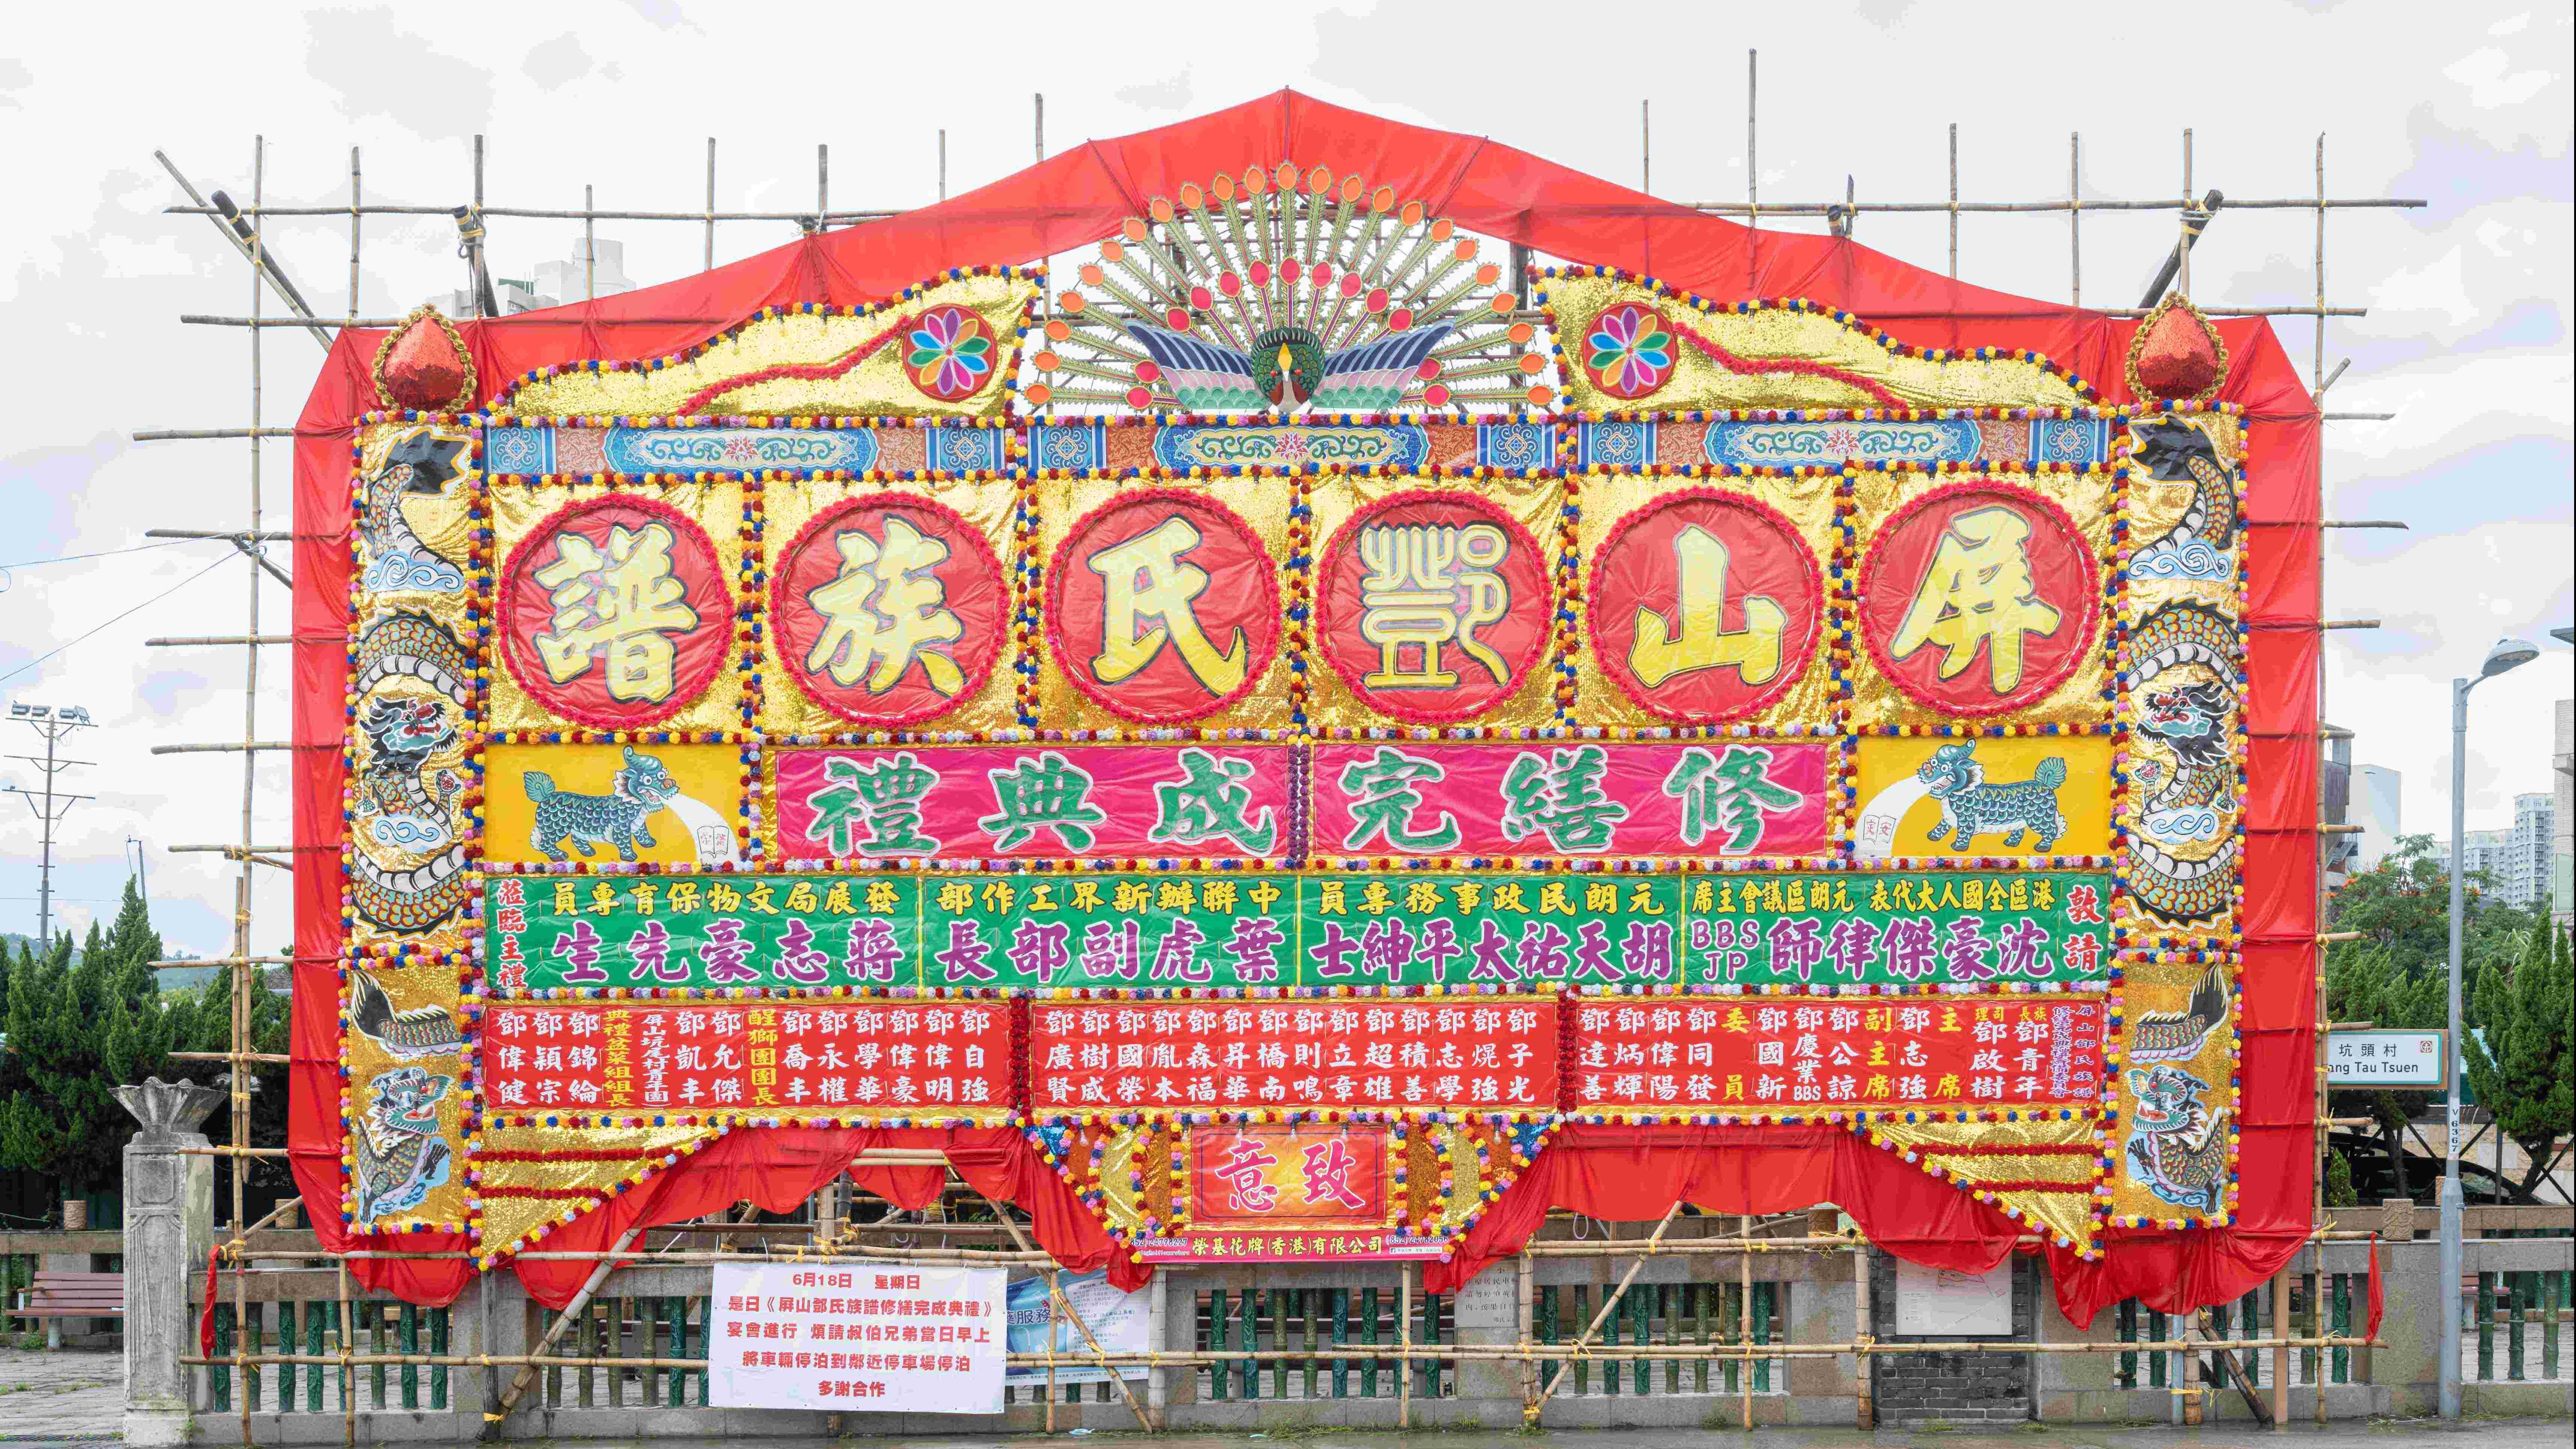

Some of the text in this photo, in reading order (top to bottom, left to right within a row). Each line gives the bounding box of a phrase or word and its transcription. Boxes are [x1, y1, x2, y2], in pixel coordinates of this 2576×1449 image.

[531, 504, 2062, 702] 屏山鄧氏族譜
[806, 744, 1805, 858] 修繕完成典禮
[496, 878, 528, 990] 蒞臨主禮
[552, 879, 902, 917] 發展局文物保育專員
[936, 880, 1283, 916] 中聯辦新界工作部
[1317, 880, 1666, 917] 元朗民政事務專員
[1690, 919, 1760, 950] BBS
[1692, 878, 2055, 915] 港區全國人大代表 元朗區議會主席
[2062, 884, 2105, 975] 敦請
[552, 918, 906, 983] 蔣志豪先生
[934, 918, 1286, 983] 葉虎副部長
[1308, 918, 1674, 983] 胡天祐太平紳士
[1703, 950, 1748, 981] JP
[1766, 916, 2055, 982] 沈豪傑律師
[531, 1012, 563, 1103] 鄧穎宗
[567, 1012, 602, 1104] 鄧錦綸
[748, 1009, 780, 1106] 醒獅團團長
[816, 1010, 850, 1103] 鄧永權
[852, 1010, 883, 1103] 鄧學華
[889, 1009, 920, 1103] 鄧偉豪
[923, 1009, 954, 1102] 鄧偉明
[958, 1010, 990, 1102] 鄧自強
[1044, 1010, 1076, 1103] 鄧廣賢
[1079, 1010, 1111, 1103] 鄧樹威
[1115, 1010, 1146, 1103] 鄧國榮
[1185, 1009, 1218, 1102] 鄧森福
[1256, 1009, 1289, 1102] 鄧橋南
[1293, 1008, 1323, 1102] 鄧則鳴
[1328, 1008, 1359, 1102] 鄧立章
[1363, 1008, 1394, 1102] 鄧超雄
[1399, 1008, 1430, 1102] 鄧積善
[1435, 1008, 1465, 1102] 鄧志學
[1505, 1008, 1537, 1102] 鄧子光
[1579, 1007, 1610, 1101] 鄧達善
[1613, 1007, 1645, 1100] 鄧炳輝
[1650, 1007, 1681, 1101] 鄧偉陽
[1685, 1007, 1717, 1101] 鄧同發
[1721, 1007, 1751, 1101] 委員
[1755, 1007, 1788, 1100] 鄧國新
[1791, 1007, 1824, 1084] 鄧慶業
[1827, 1007, 1859, 1100] 鄧公諒
[1862, 1007, 1891, 1099] 副主席
[1898, 1007, 1930, 1099] 鄧志強
[1934, 1007, 1962, 1099] 主席
[2012, 1020, 2049, 1099] 鄧青年
[2072, 1004, 2096, 1097] 屏山鄧氏族譜
[2339, 1044, 2397, 1057] 坑頭村
[2354, 1062, 2376, 1073] Tau
[2381, 1062, 2418, 1073] Tsuen
[1793, 1085, 1821, 1101] BBS
[1214, 1138, 1366, 1213] 致意
[792, 1272, 921, 1290] 6月18日 星期日
[1192, 1235, 1382, 1257] 榮基花牌(香港)有限公司
[727, 1321, 990, 1344] 宴會進行 煩請叔伯兄弟當日早上
[742, 1350, 970, 1373] 將車輛停泊到鄰近停車場停泊
[818, 1380, 886, 1397] 多謝合作
